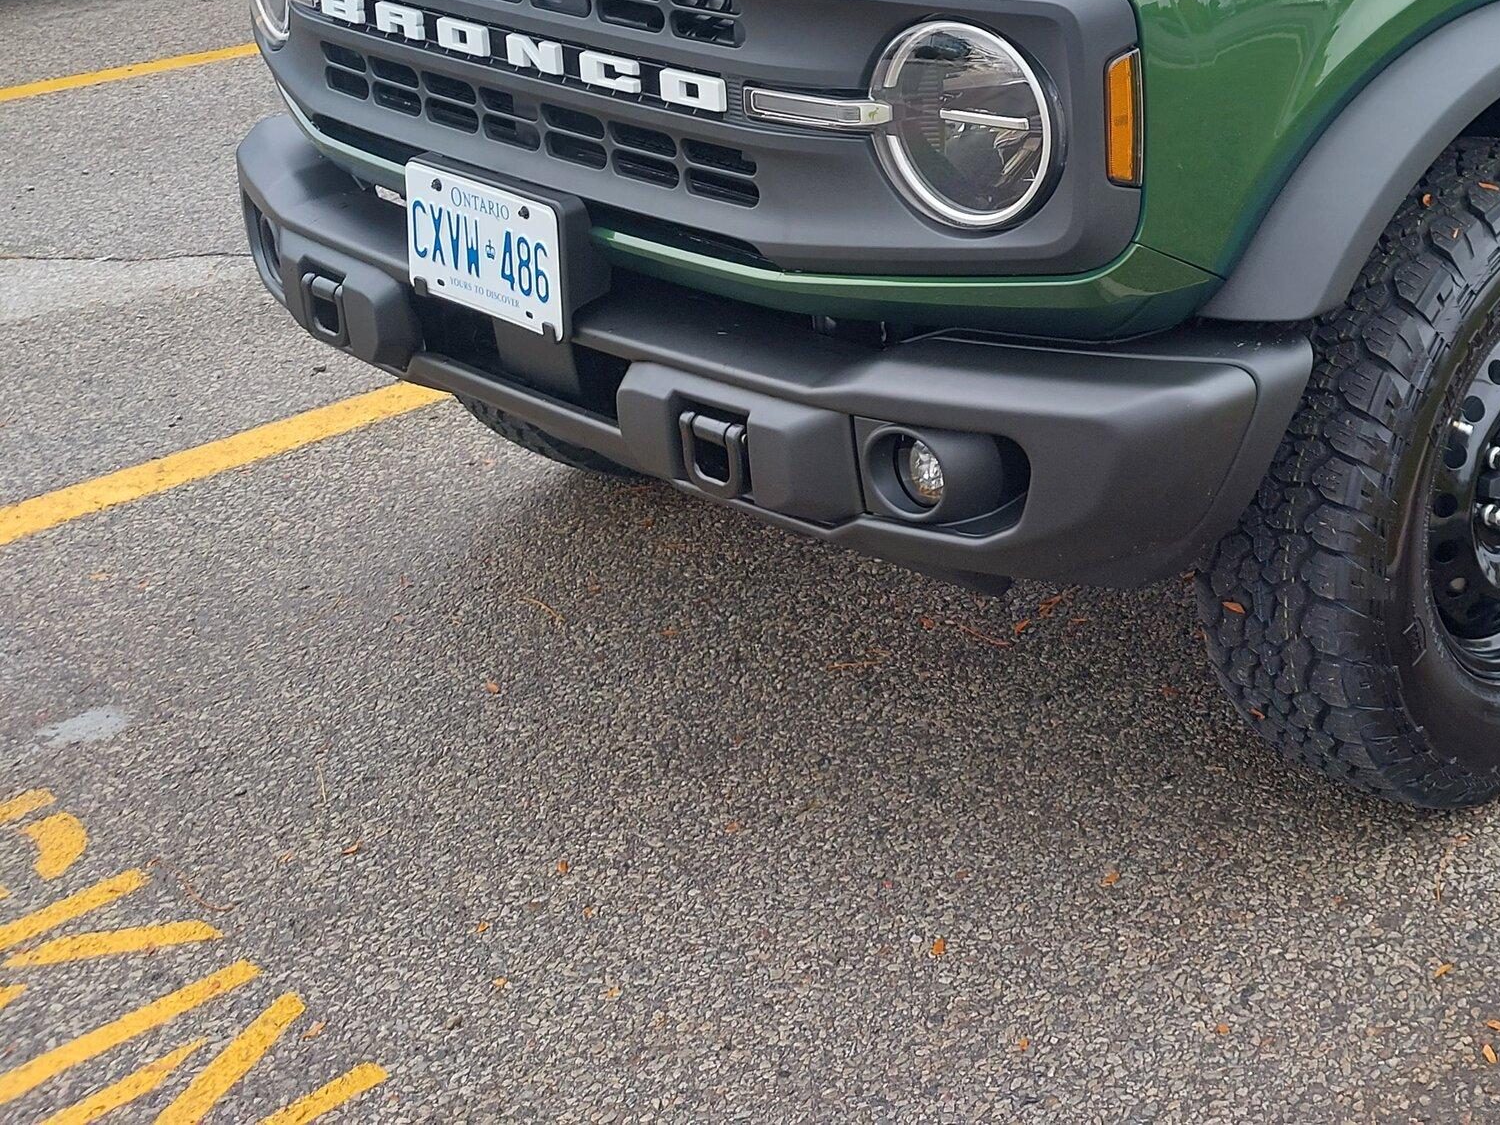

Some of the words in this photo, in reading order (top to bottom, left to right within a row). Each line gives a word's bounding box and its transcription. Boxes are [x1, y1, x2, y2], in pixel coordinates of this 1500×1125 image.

[450, 186, 510, 221] ONTARIO
[412, 199, 480, 278] CXVW
[501, 230, 550, 304] 486
[451, 277, 473, 292] YOURS
[474, 285, 485, 296] TO
[485, 289, 521, 308] DISCOVER
